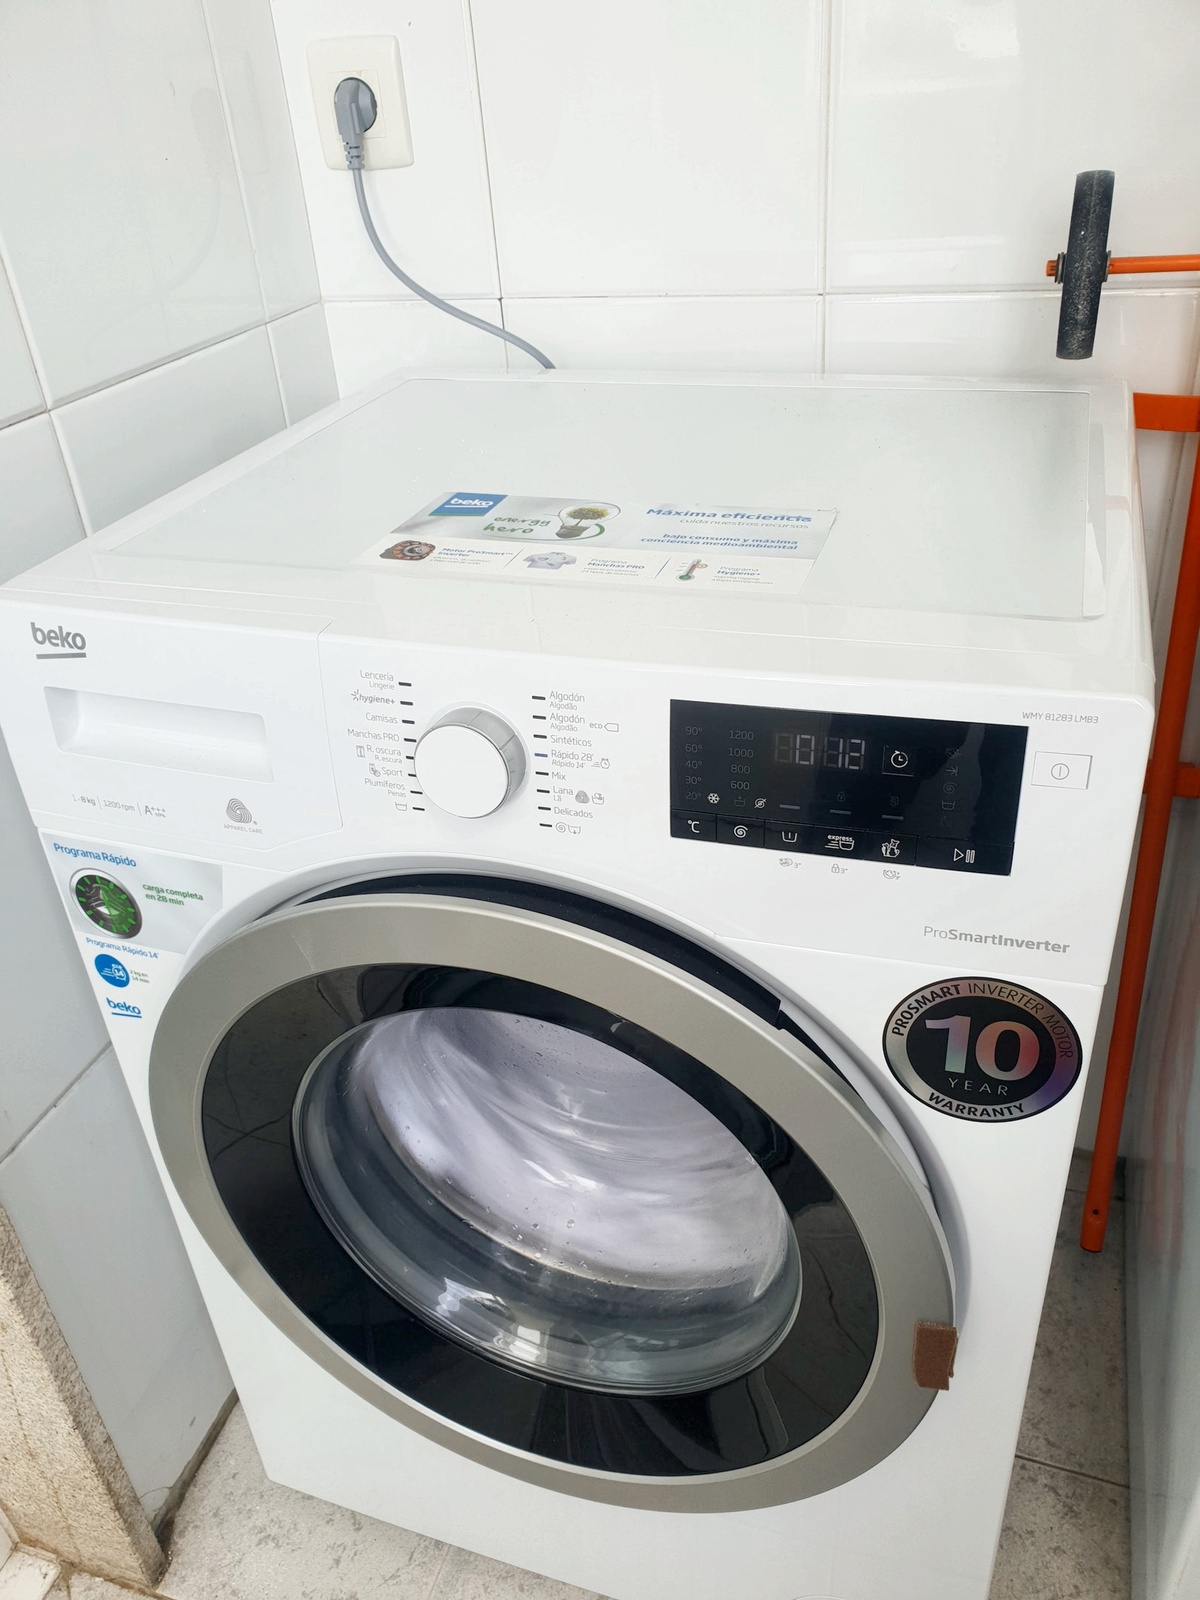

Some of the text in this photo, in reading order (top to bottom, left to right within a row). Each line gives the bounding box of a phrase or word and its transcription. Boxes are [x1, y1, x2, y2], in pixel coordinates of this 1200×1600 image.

[450, 498, 494, 507] beko
[646, 508, 718, 519] Máxima
[493, 516, 552, 527] energy
[679, 517, 809, 530] cuida nuestros recursos
[482, 524, 534, 534] hero
[640, 537, 799, 550] conciencia medioambiental
[662, 533, 688, 541] bajo
[689, 535, 741, 543] consumo
[30, 621, 87, 651] beko
[360, 669, 394, 682] Lencería
[368, 681, 395, 690] Lingerie
[359, 693, 396, 705] hygiene+
[549, 690, 585, 703] Algodón
[549, 701, 578, 711] Algodão
[365, 712, 398, 724] Camisas
[549, 712, 603, 730] Algodón eco
[1022, 711, 1099, 724] WMY 81283 LMB3
[549, 722, 578, 732] Algodão
[347, 728, 400, 743] Manchas PRO
[550, 734, 592, 748] Sintéticos
[729, 730, 754, 741] 1200
[366, 744, 402, 757] R. oscura
[551, 749, 580, 761] Rápido
[728, 747, 754, 758] 1000
[382, 756, 403, 765] escura
[381, 767, 403, 778] Sport
[730, 764, 751, 774] 800
[551, 771, 566, 781] Mix
[364, 778, 406, 791] Plumíferos
[552, 785, 574, 796] Lana
[730, 780, 750, 791] 600
[388, 789, 407, 798] Penas
[103, 799, 121, 809] 1200
[121, 803, 136, 812] rpm
[553, 806, 594, 819] Delicados
[827, 834, 853, 842] express
[53, 842, 137, 868] Programa Rápido
[142, 883, 204, 901] carga completa
[145, 893, 185, 906] en 28 min
[85, 936, 121, 951] Programa
[121, 945, 148, 957] Rápido
[106, 996, 142, 1016] beko
[891, 983, 1074, 1059] PROSMART INVERTER MOTOR
[925, 1014, 1040, 1081] 10
[948, 1077, 1009, 1096] YEAR
[928, 1091, 1025, 1118] WARRANTY
